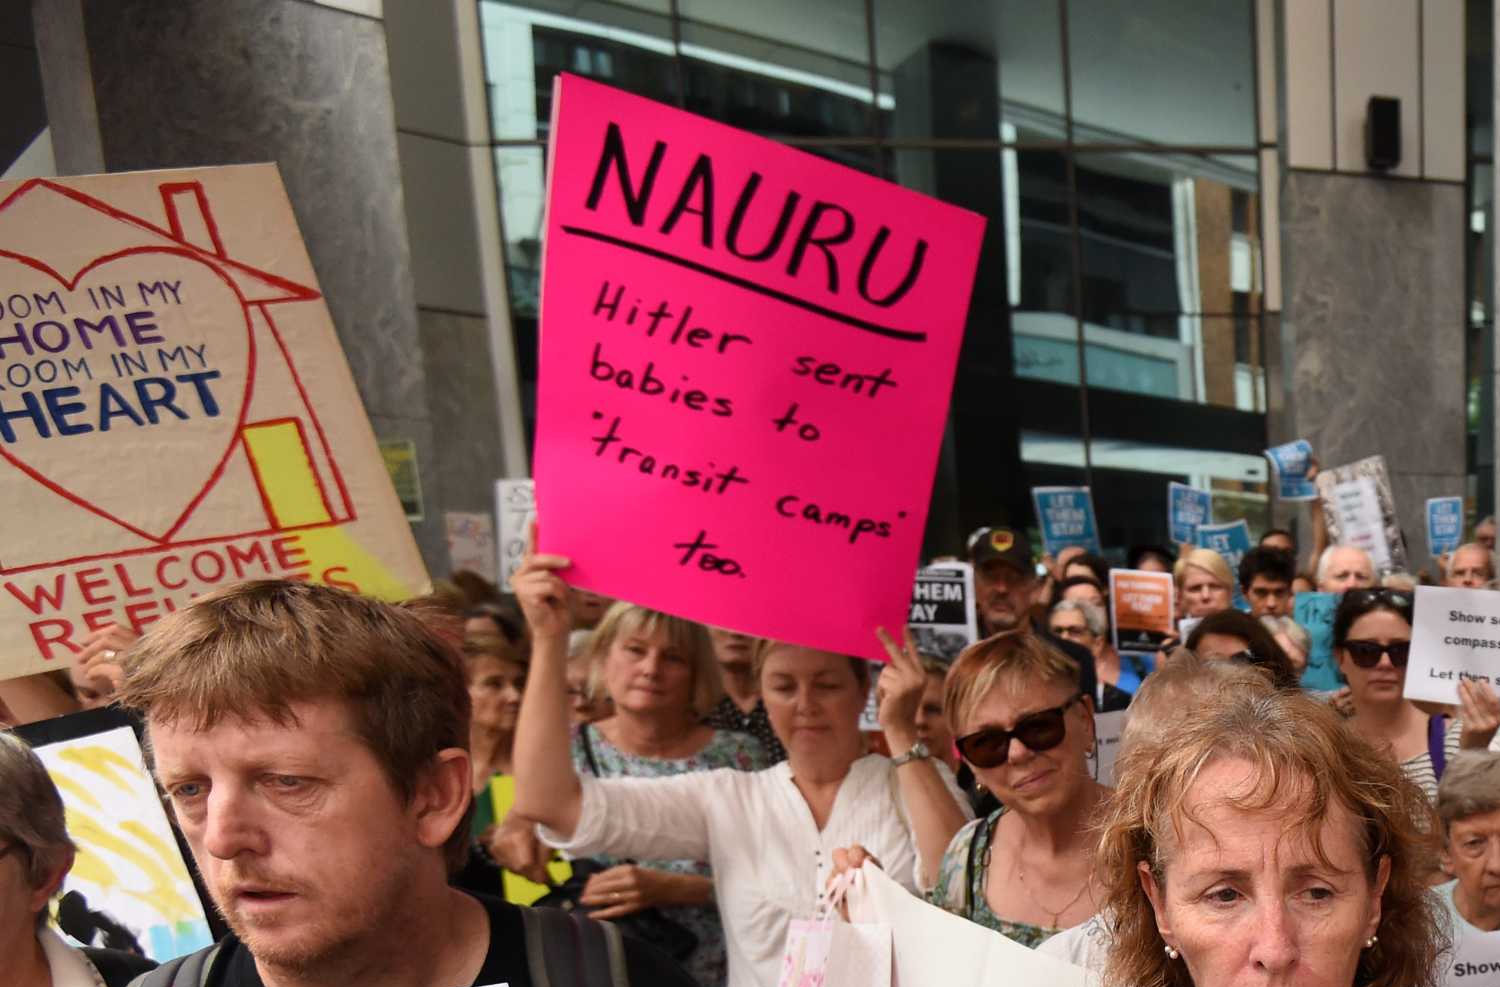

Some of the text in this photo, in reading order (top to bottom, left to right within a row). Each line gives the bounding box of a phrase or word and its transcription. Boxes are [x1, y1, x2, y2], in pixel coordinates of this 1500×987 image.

[584, 121, 928, 308] NAURU
[88, 282, 126, 311] IN
[138, 280, 182, 305] MY
[0, 311, 165, 360] HOME
[593, 280, 897, 400] Hitler sent
[0, 343, 207, 391] OOM IN MY
[0, 370, 222, 445] HEART
[590, 343, 821, 442] babies to
[4, 535, 312, 616] WELCOME
[914, 583, 963, 602] HEM
[1449, 610, 1486, 625] Show
[1429, 667, 1454, 681] Let
